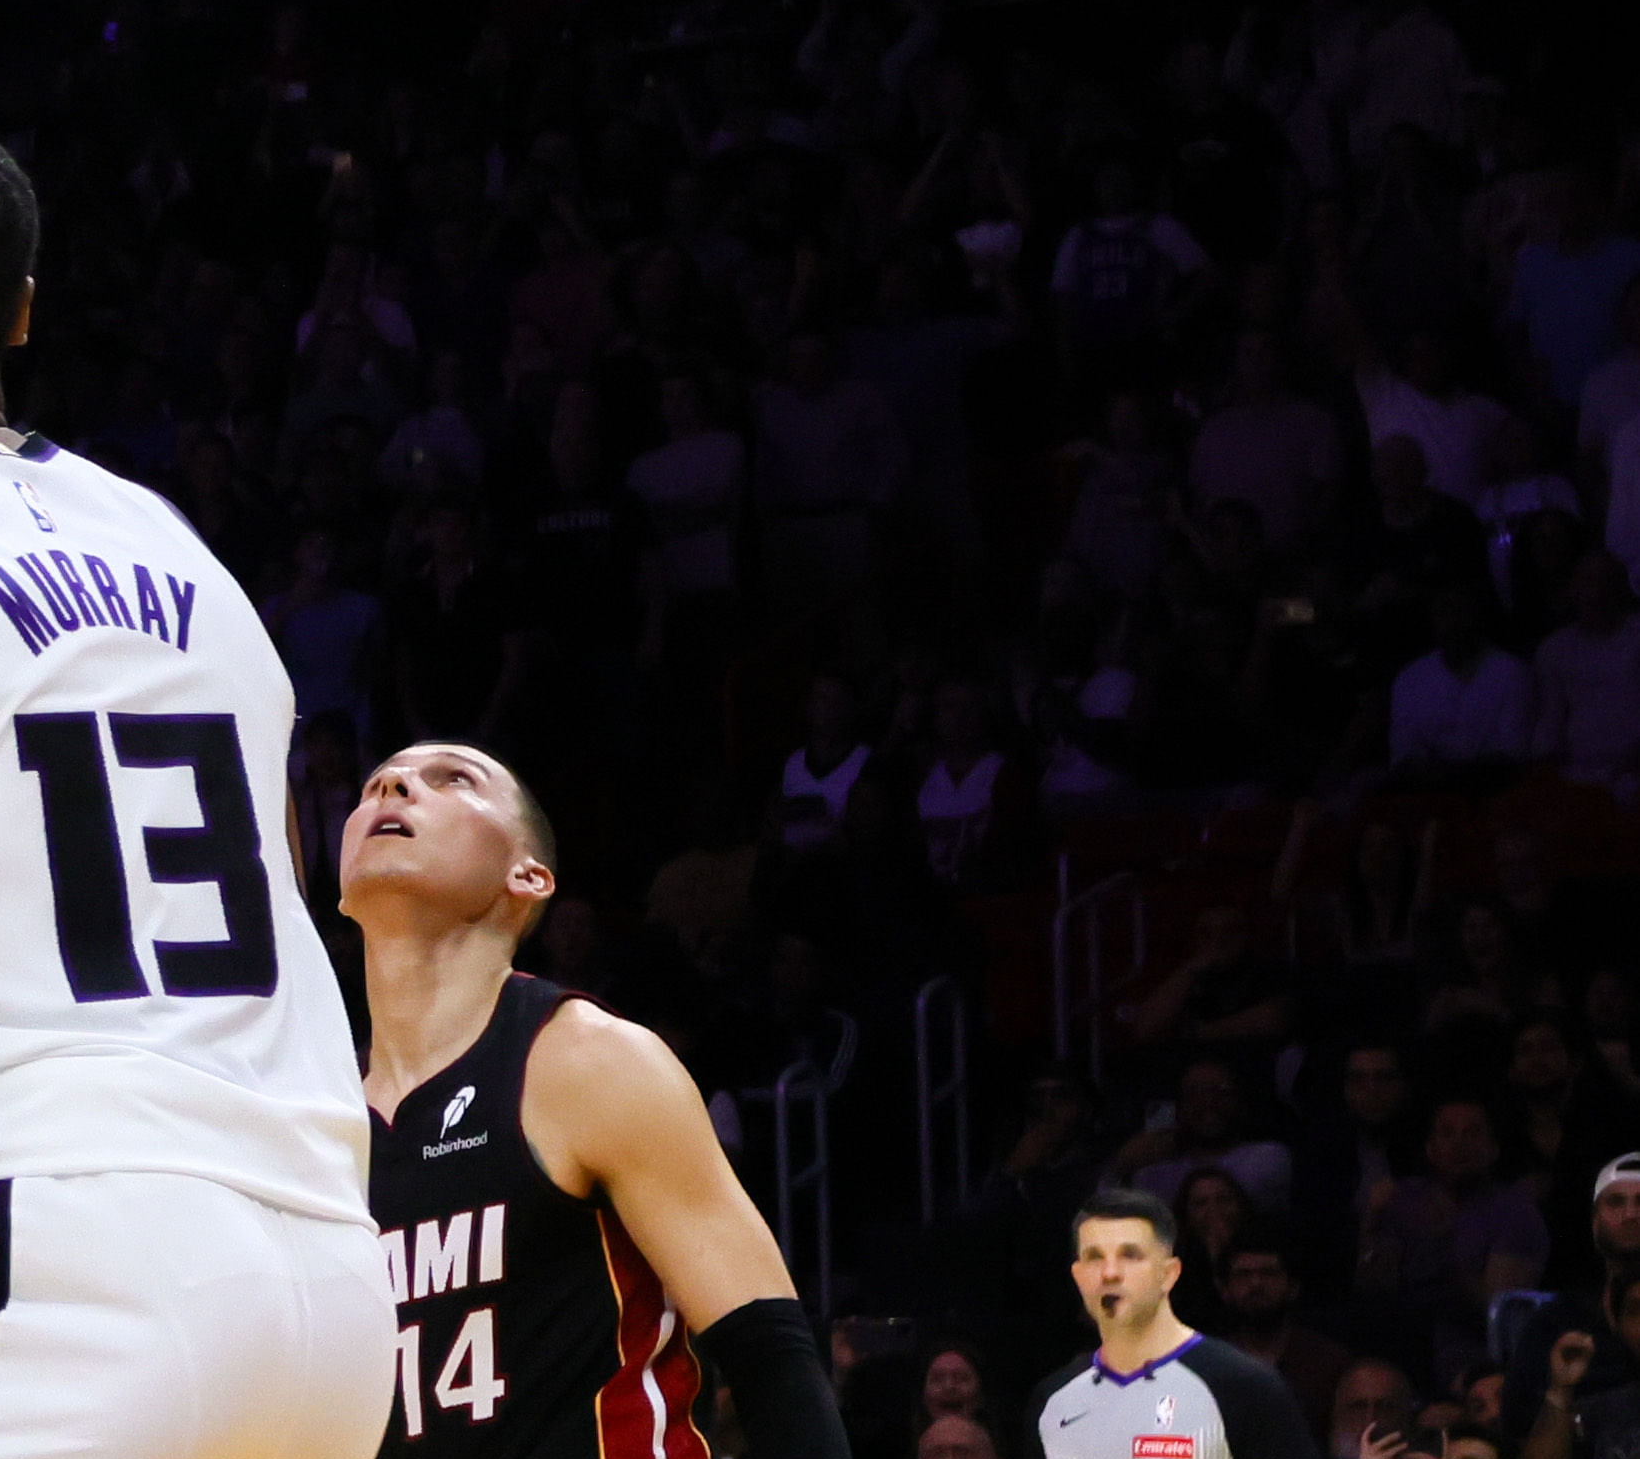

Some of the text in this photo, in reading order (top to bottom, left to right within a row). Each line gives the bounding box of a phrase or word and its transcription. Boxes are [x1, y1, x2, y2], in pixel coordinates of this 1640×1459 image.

[13, 710, 279, 1004] 13
[422, 1131, 488, 1161] Robinhood
[380, 1202, 507, 1305] AMI
[396, 1307, 506, 1438] 14
